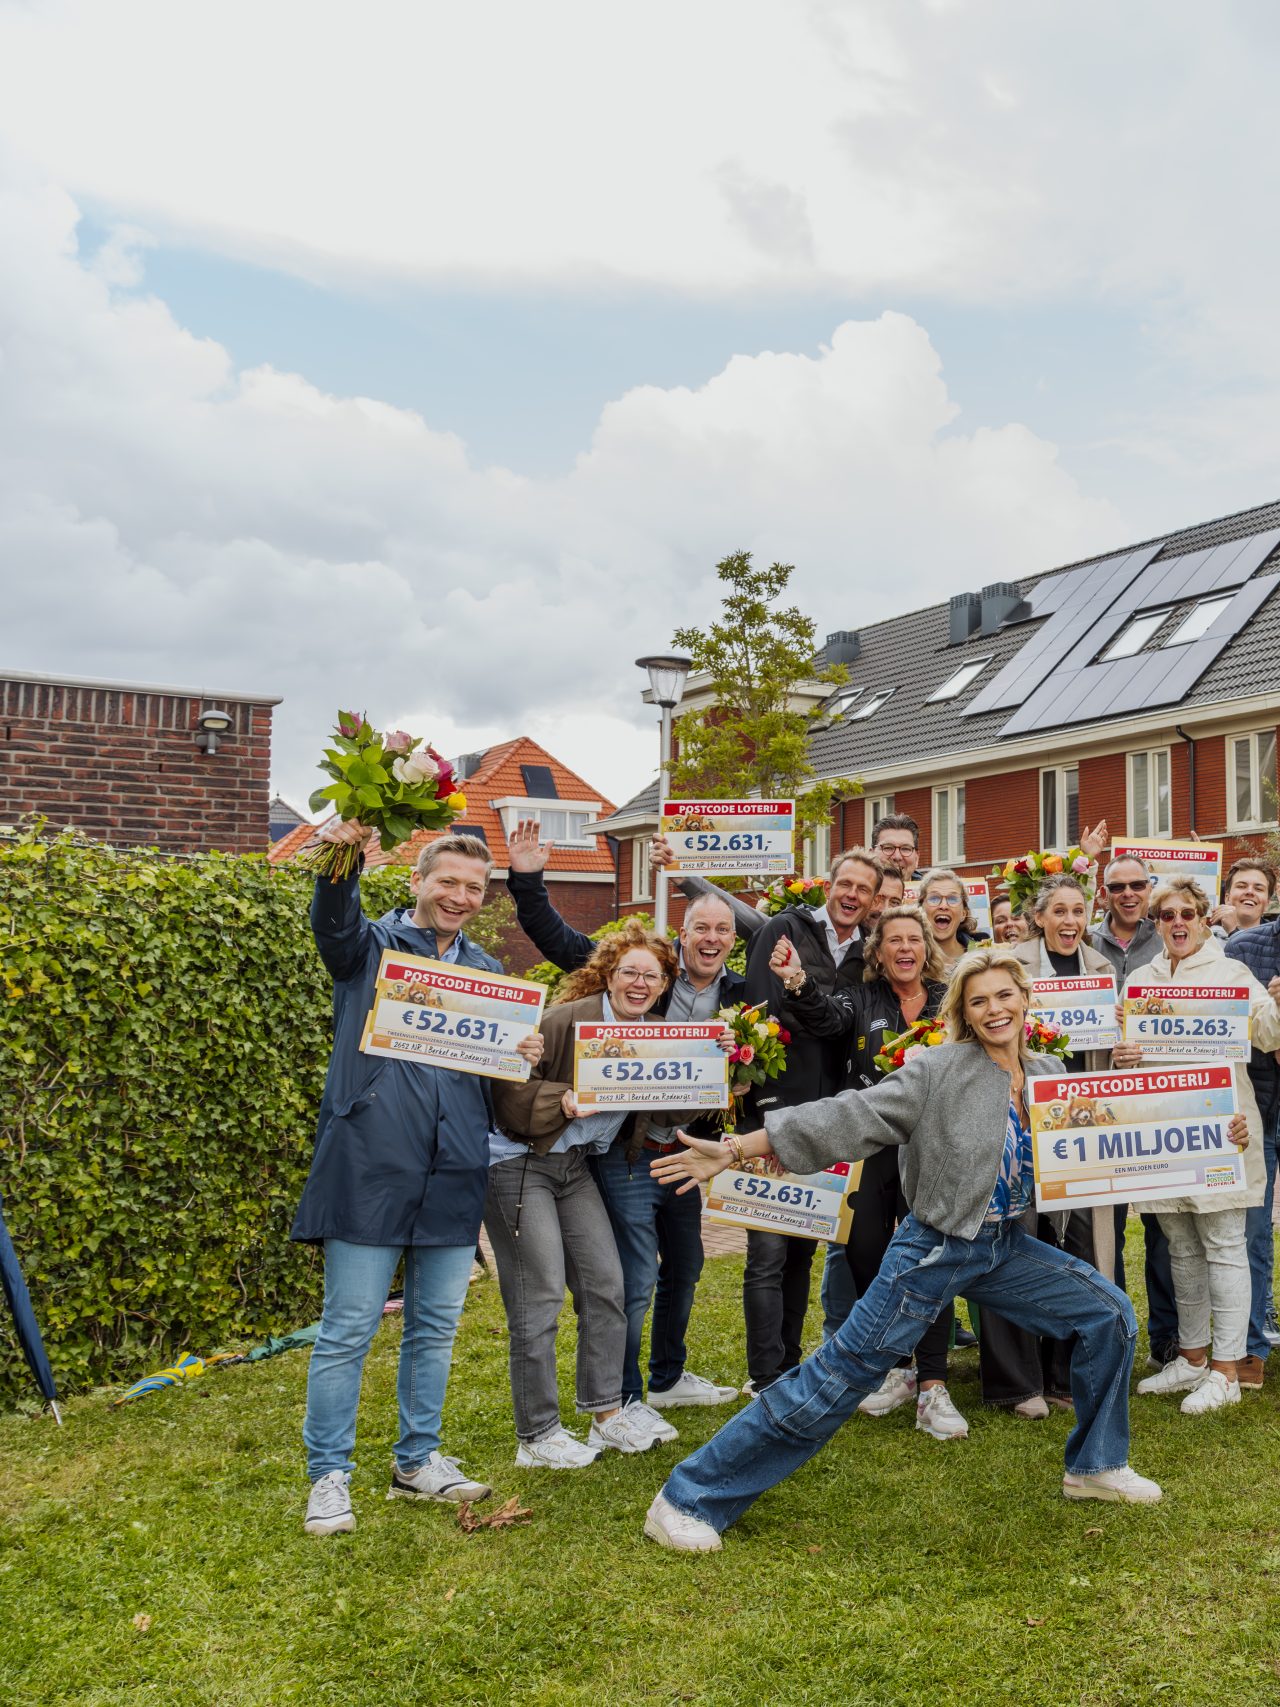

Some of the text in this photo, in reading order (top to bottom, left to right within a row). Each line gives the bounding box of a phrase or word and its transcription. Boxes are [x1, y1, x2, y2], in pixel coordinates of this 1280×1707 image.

[680, 805, 778, 813] POSTCODE LOTERIJ
[685, 834, 772, 851] € 52.631,-
[1126, 850, 1206, 860] POSTCODE LOTERIJ
[404, 970, 524, 1000] POSTCODE LOTERIJ
[1033, 980, 1100, 990] CODE LOTERIJ
[1141, 988, 1235, 998] POSTCODE LOTERIJ
[402, 1010, 508, 1045] € 52.631,-
[597, 1028, 709, 1037] POSTCODE LOTERIJ
[1138, 1019, 1236, 1037] € 105.263,-
[602, 1061, 702, 1081] € 52.631,-
[1057, 1072, 1210, 1096] POSTCODE LOTERIJ
[1099, 1124, 1223, 1160] MILJOEN
[1127, 1164, 1152, 1172] MILJOEN
[734, 1178, 744, 1190] €
[744, 1178, 821, 1210] 52.631,-
